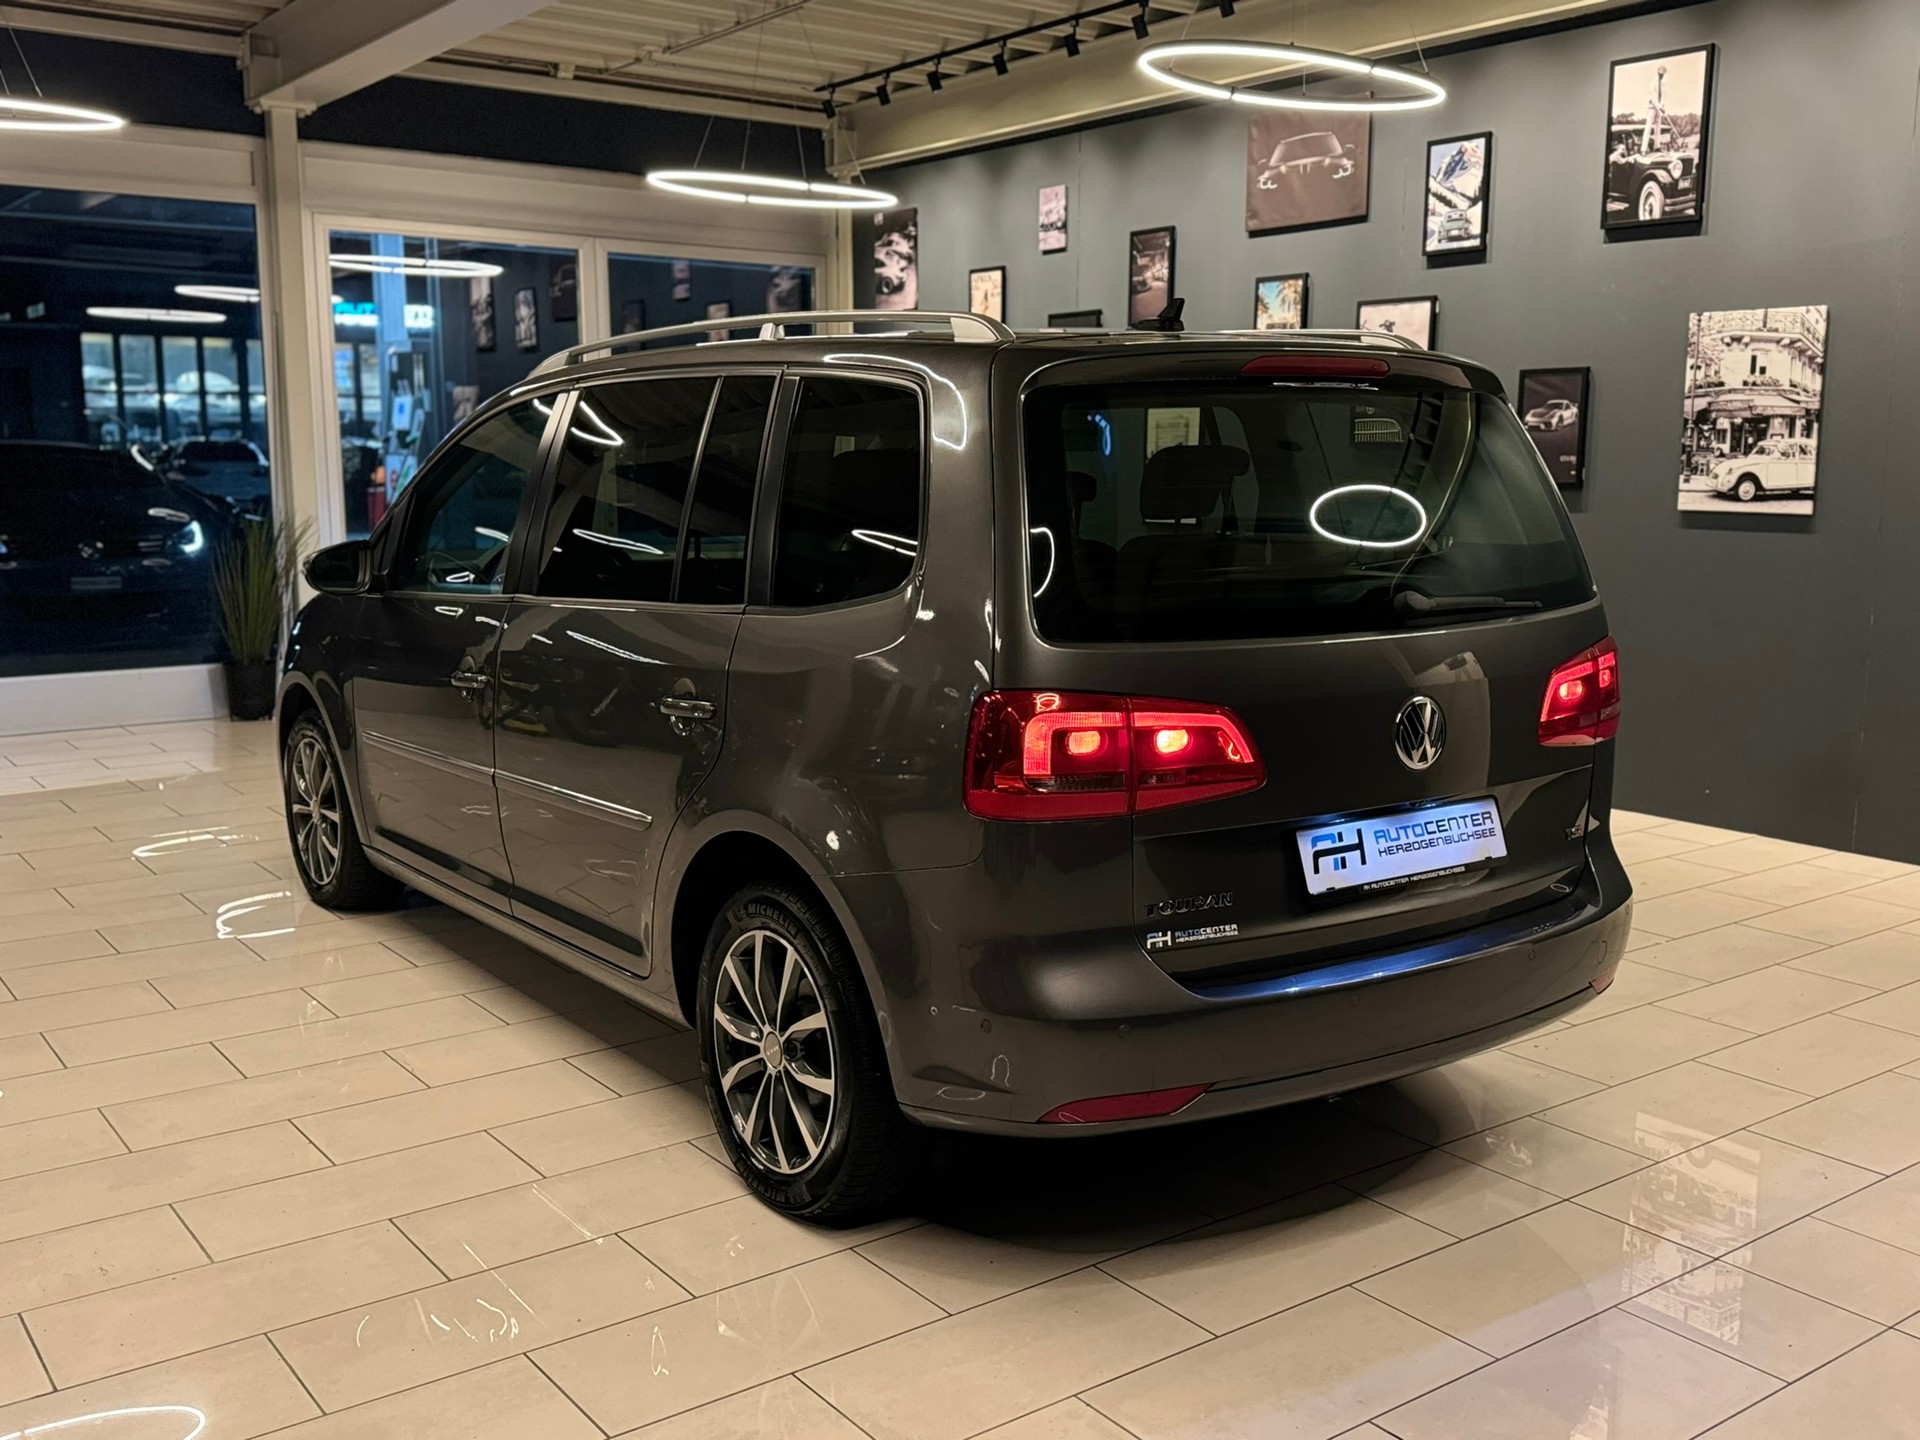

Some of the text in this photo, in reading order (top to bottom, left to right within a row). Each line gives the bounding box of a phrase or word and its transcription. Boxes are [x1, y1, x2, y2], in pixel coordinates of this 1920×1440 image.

[1374, 811, 1494, 845] AUTOCENTER
[1377, 827, 1497, 857] HERZOGENBUCHSEE
[1371, 877, 1410, 889] AUTOCENTER
[1144, 892, 1233, 917] TOURAN
[747, 903, 798, 937] MICHELIN
[1174, 923, 1239, 937] AUTOCENTER
